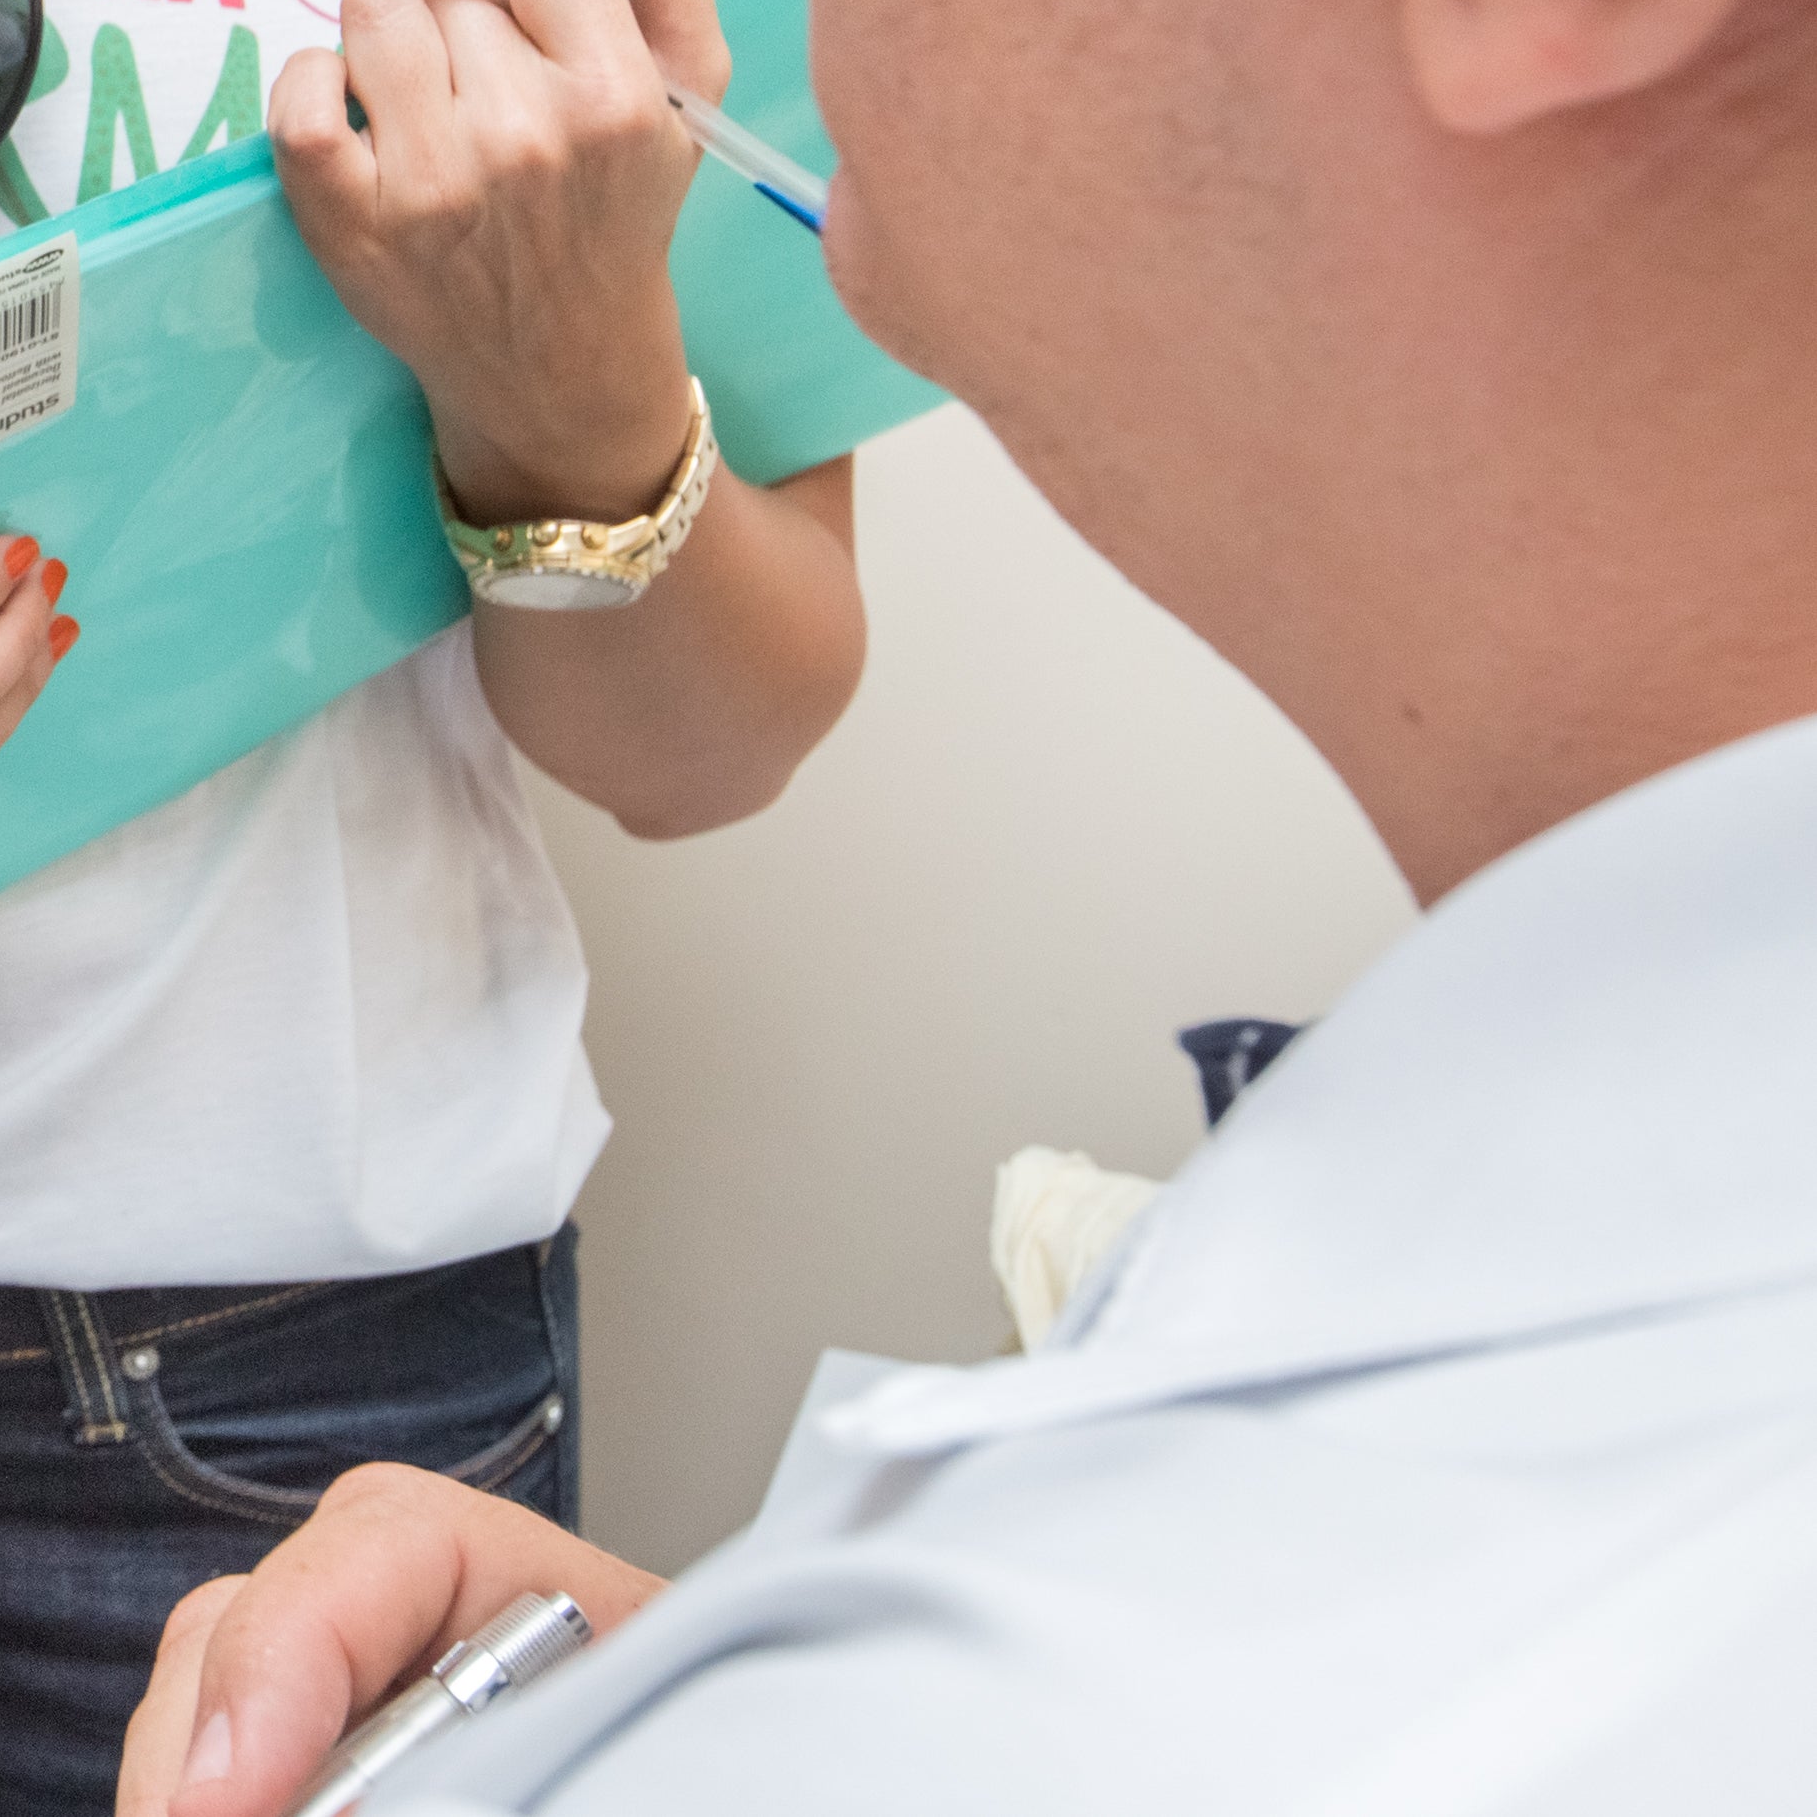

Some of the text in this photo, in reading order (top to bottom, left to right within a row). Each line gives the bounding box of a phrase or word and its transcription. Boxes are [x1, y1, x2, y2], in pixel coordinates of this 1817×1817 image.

[35, 352, 61, 368] with
[1, 373, 60, 405] Horizontal
[2, 362, 61, 393] Document
